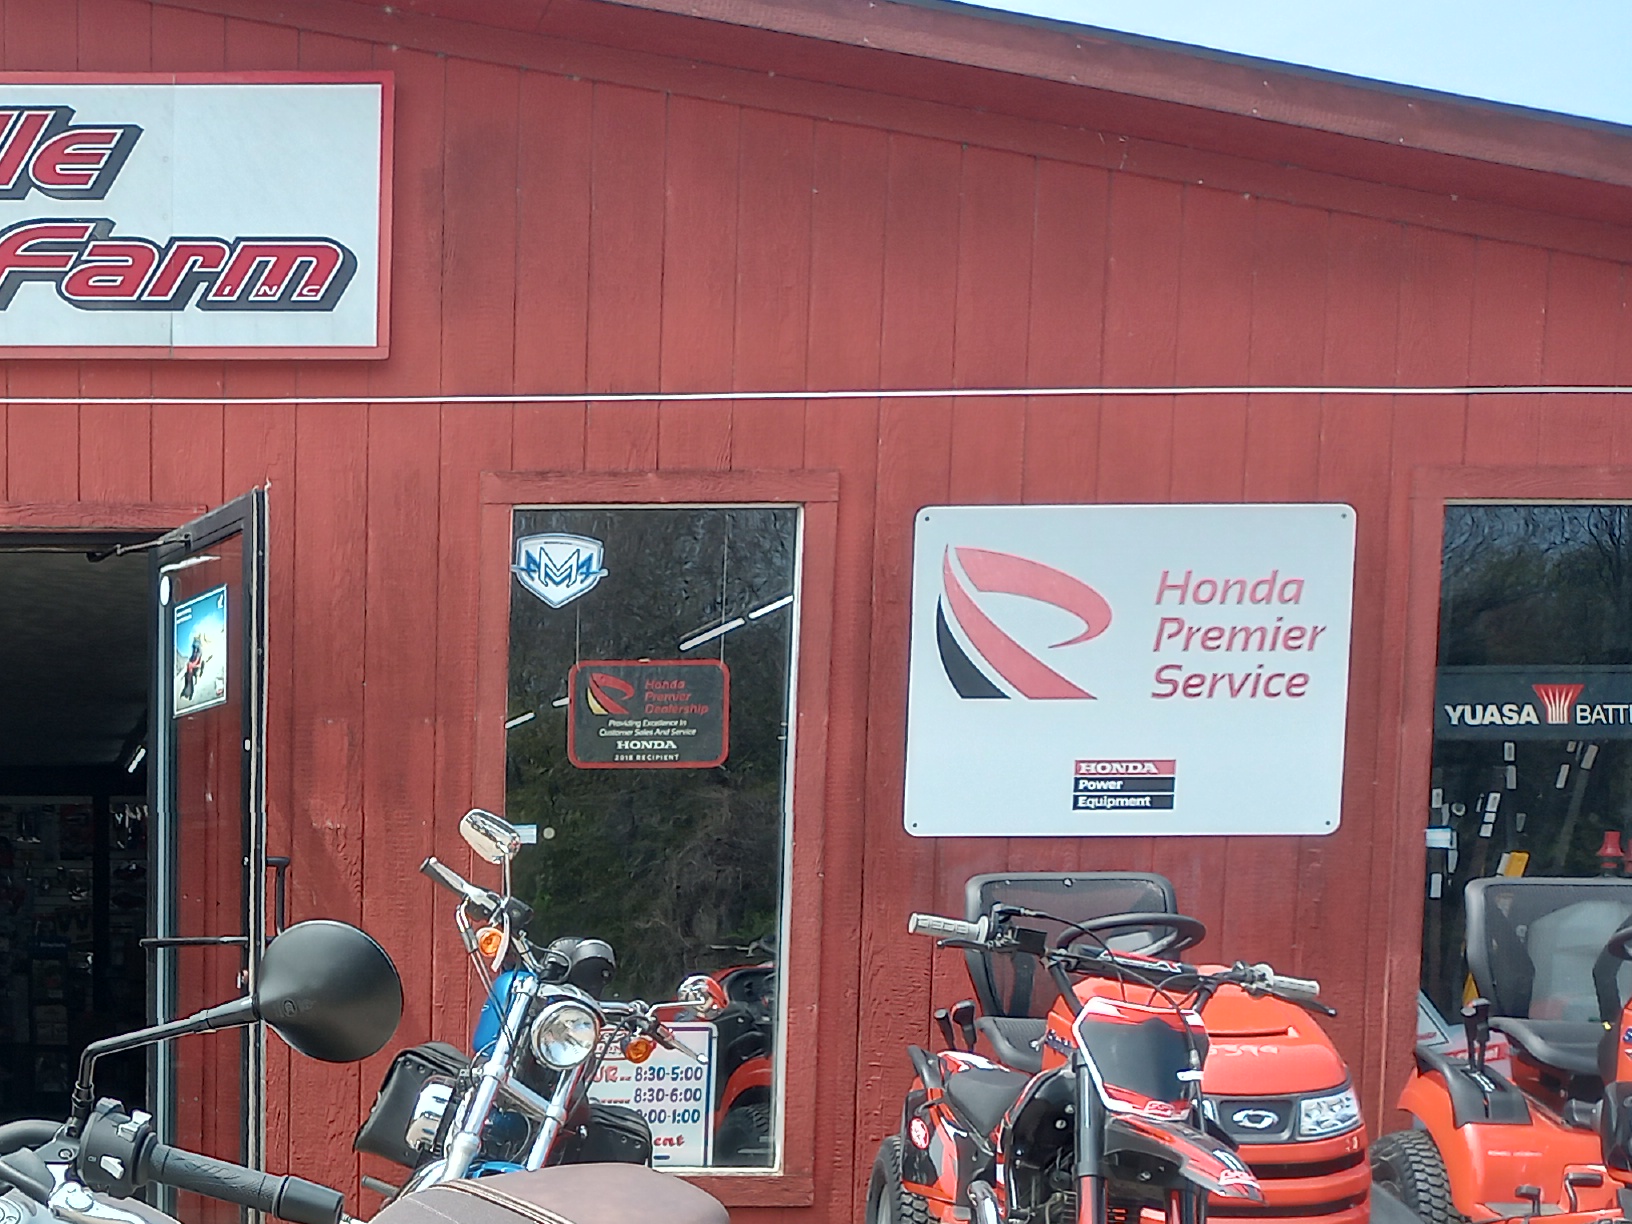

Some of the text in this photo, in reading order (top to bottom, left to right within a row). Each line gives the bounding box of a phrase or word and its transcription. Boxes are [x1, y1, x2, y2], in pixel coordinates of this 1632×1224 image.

[1154, 570, 1305, 606] Honda
[1152, 616, 1327, 652] Premier
[644, 679, 686, 690] Honda
[1151, 663, 1310, 699] Service
[644, 691, 692, 702] Premier
[644, 703, 710, 715] Dealership
[1444, 704, 1540, 725] YUASA
[671, 729, 697, 737] Service
[616, 740, 678, 750] HONDA
[635, 753, 680, 762] RECIPIENT
[1077, 762, 1159, 775] HONDA
[1077, 779, 1124, 791] Power
[1076, 796, 1152, 809] Equipment
[634, 1066, 704, 1081] 8:30-5:00
[633, 1087, 703, 1103] 8:30-6:00
